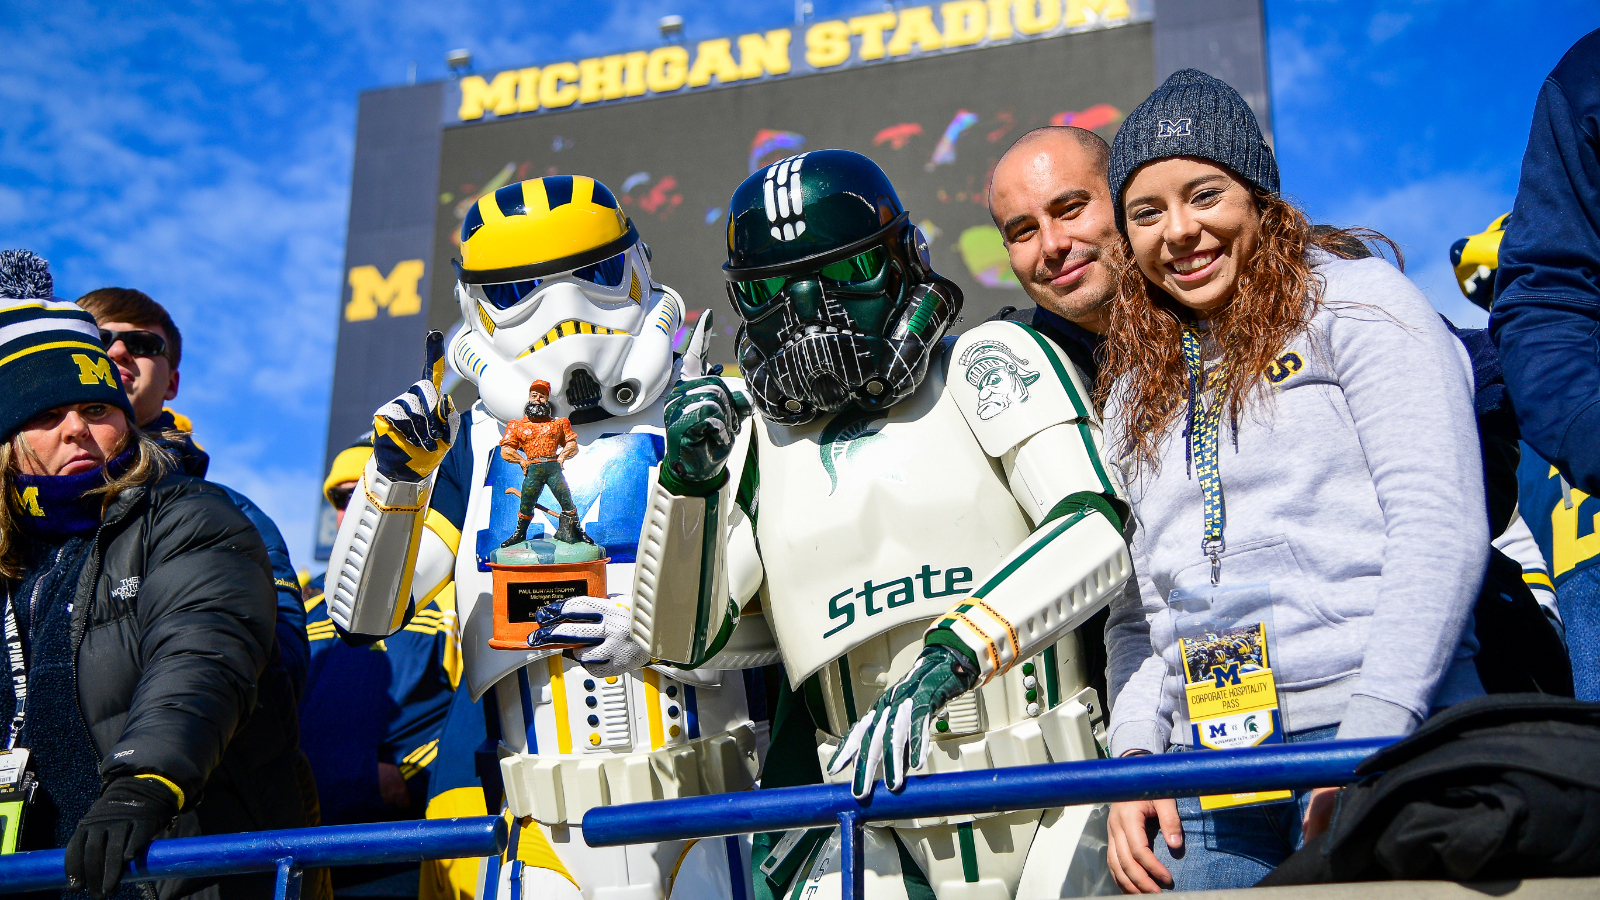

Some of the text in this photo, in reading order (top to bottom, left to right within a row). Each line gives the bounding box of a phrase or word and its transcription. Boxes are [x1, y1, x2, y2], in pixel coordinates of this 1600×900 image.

[458, 0, 1130, 121] MICHIGAN STADIUM
[1158, 118, 1191, 137] M
[345, 259, 425, 322] M
[71, 354, 118, 389] M
[12, 486, 46, 517] M
[111, 584, 139, 598] NORTH
[120, 576, 139, 586] THE
[822, 564, 974, 639] State
[5, 612, 19, 640] PINK
[8, 641, 25, 672] PINK
[13, 675, 27, 700] PIN
[1210, 661, 1243, 688] M
[1191, 682, 1268, 705] CORPORATE HOSPITALITY
[1222, 698, 1240, 709] PASS
[1209, 722, 1227, 739] M
